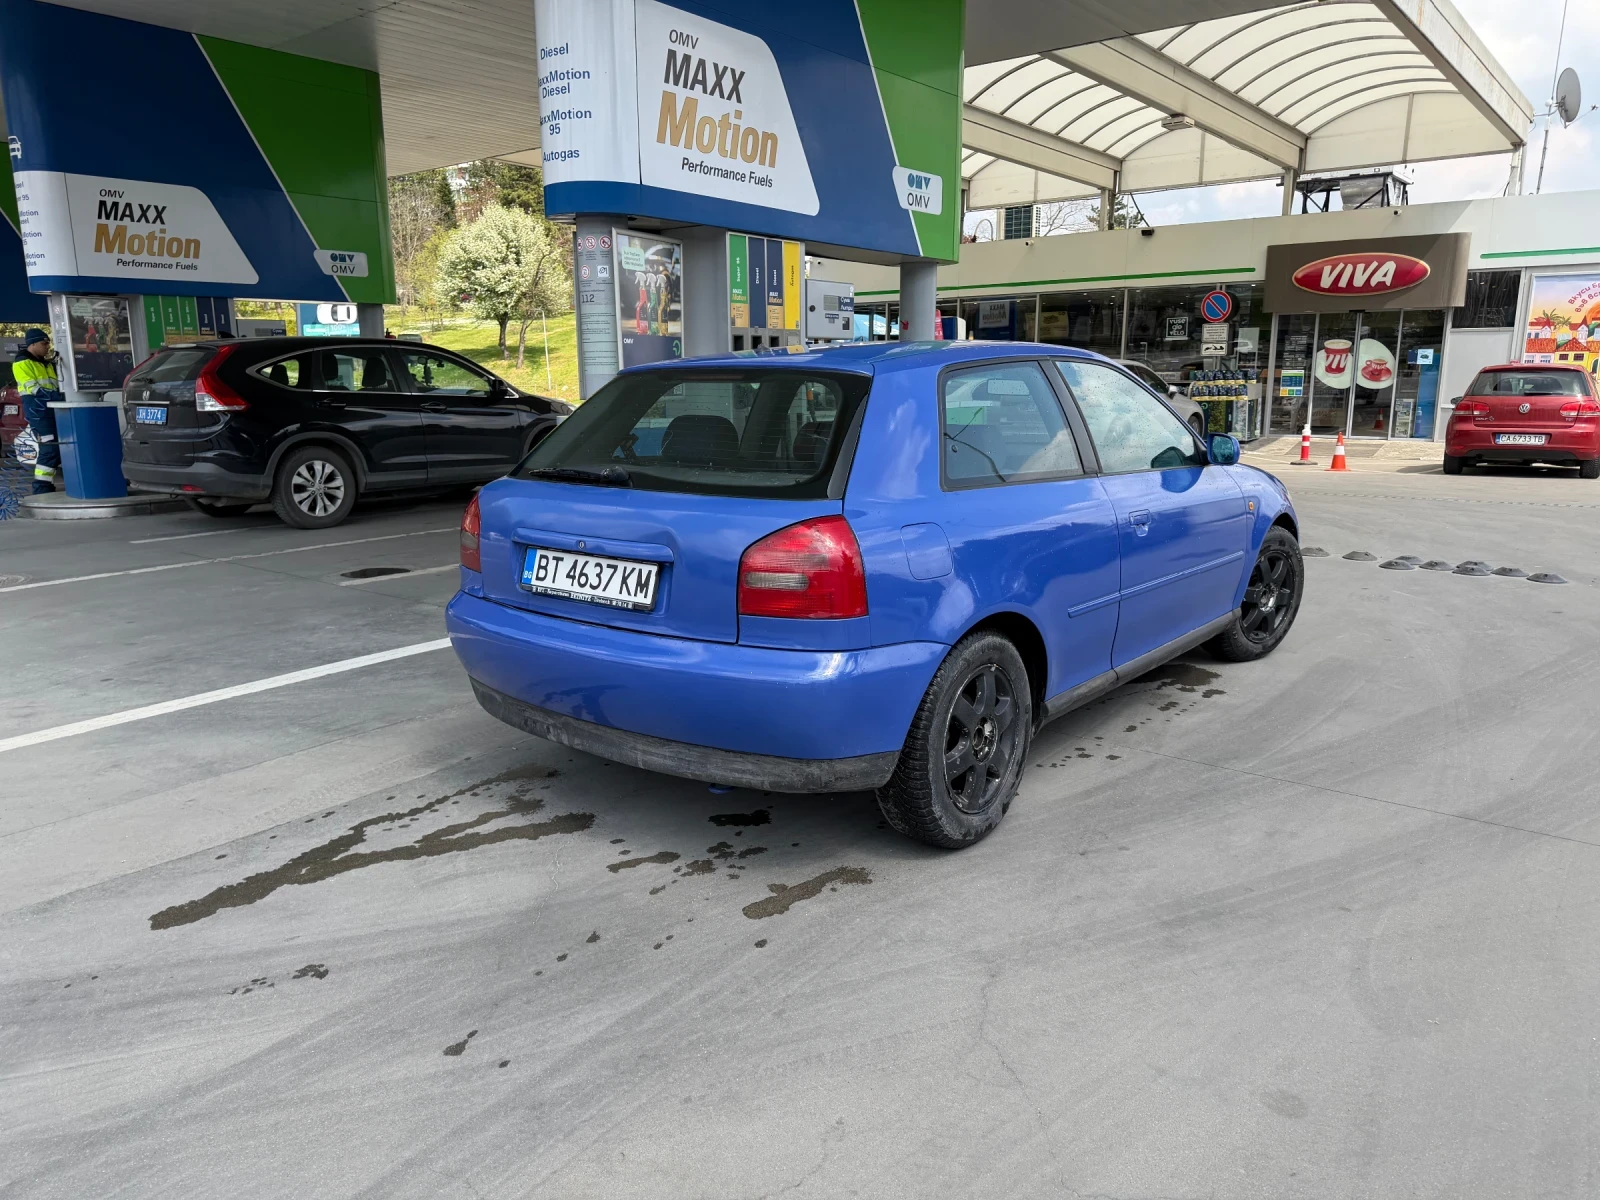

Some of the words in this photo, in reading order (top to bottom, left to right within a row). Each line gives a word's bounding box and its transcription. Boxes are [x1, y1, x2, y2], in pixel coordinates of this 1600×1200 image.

[669, 29, 699, 50] OMV
[540, 42, 569, 60] Diesel
[538, 68, 591, 88] axxMotion
[664, 48, 746, 104] MAXX
[542, 82, 571, 99] Diesel
[549, 123, 561, 135] 95
[656, 90, 778, 168] Motion
[543, 149, 580, 163] Autogas
[681, 157, 746, 183] Performance
[748, 171, 773, 188] Fuels
[100, 189, 124, 199] OMV
[907, 192, 930, 209] OMV
[97, 200, 167, 225] MAXX
[94, 223, 201, 260] Motion
[116, 258, 174, 270] Performance
[175, 262, 198, 271] Fuels
[331, 264, 355, 275] OMV
[1320, 261, 1396, 289] VIVA
[581, 294, 595, 304] 112
[1513, 434, 1532, 443] 6733
[1533, 435, 1543, 443] TB
[523, 570, 532, 579] BG
[535, 554, 564, 584] BT
[565, 559, 619, 592] 4637
[619, 566, 653, 599] KM
